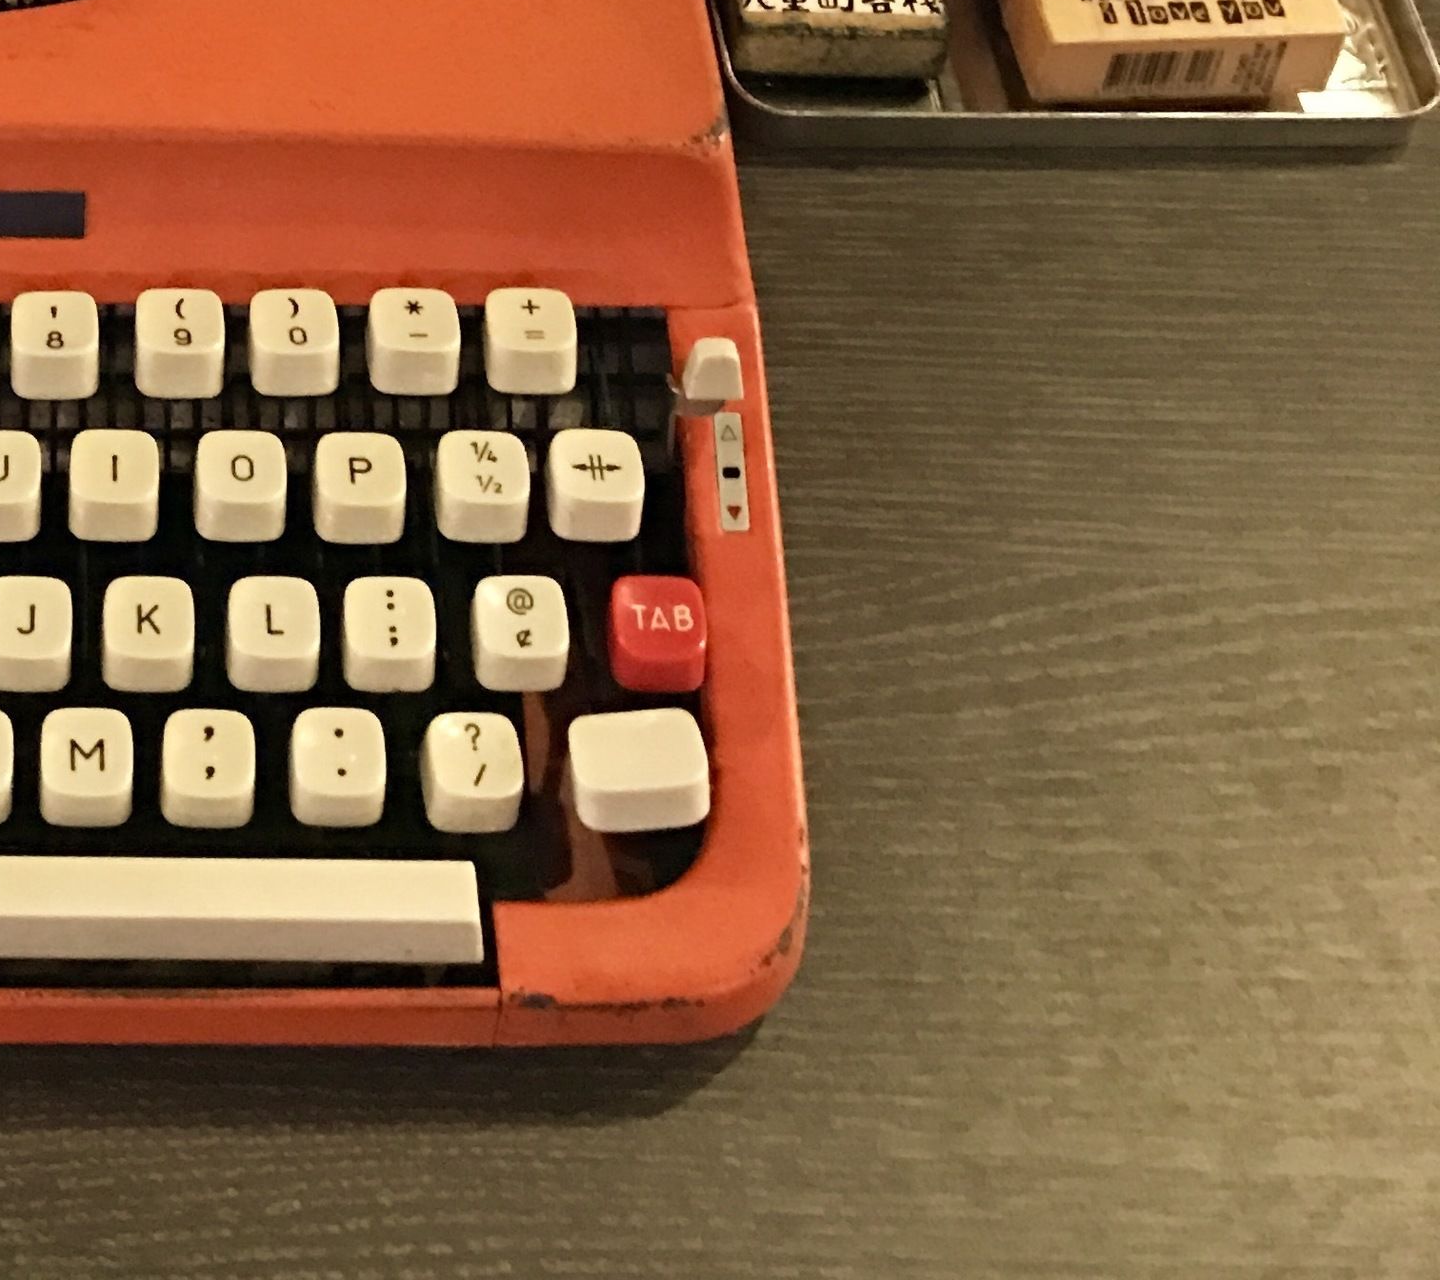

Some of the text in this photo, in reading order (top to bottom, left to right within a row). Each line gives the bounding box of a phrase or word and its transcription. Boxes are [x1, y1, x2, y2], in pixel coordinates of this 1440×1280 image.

[45, 330, 65, 351] 8
[173, 327, 193, 347] 9
[287, 326, 309, 346] 0
[111, 454, 119, 483] I
[230, 453, 255, 483] O
[347, 456, 373, 485] P
[16, 603, 37, 636] J
[135, 603, 161, 636] K
[264, 603, 285, 636] L
[631, 603, 695, 632] TAB
[68, 738, 106, 773] M
